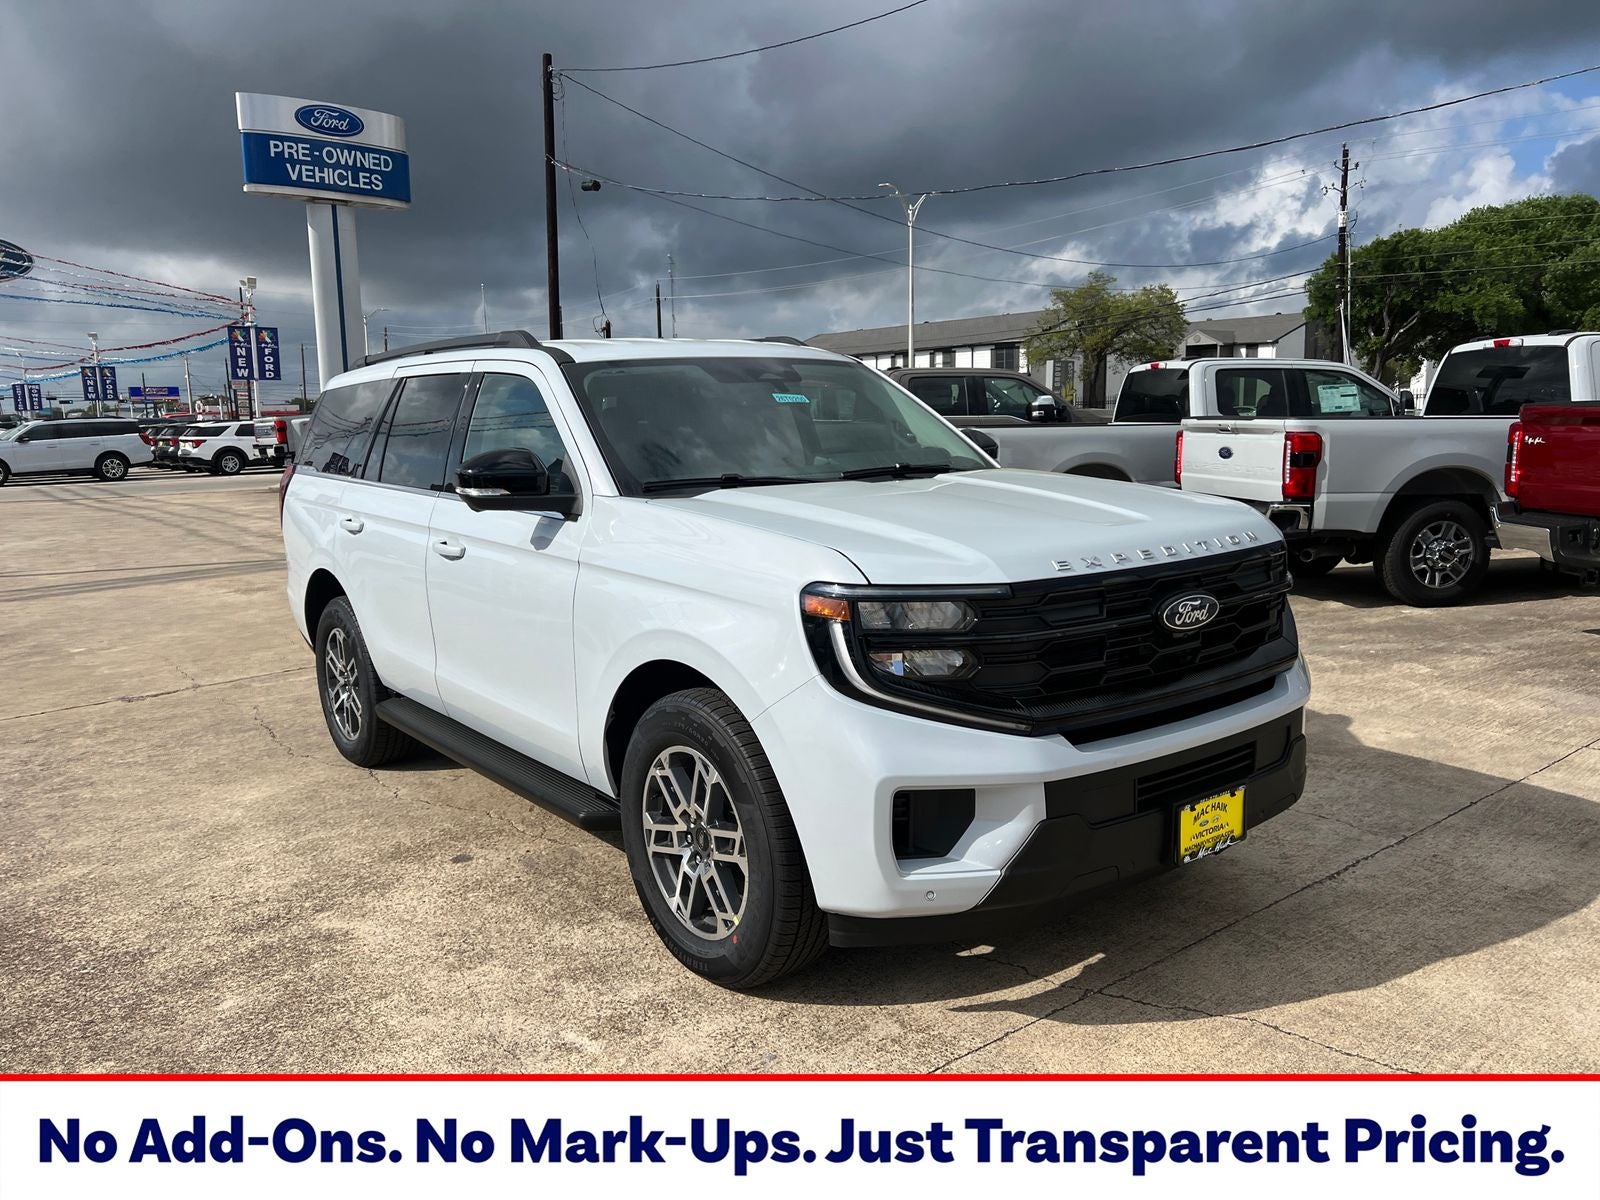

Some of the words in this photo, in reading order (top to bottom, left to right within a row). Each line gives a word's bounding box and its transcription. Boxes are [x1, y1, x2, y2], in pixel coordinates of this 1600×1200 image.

[310, 108, 349, 131] Ford
[286, 163, 383, 191] VEHICLES
[236, 347, 249, 377] NEW
[264, 348, 275, 378] FORD
[1051, 531, 1258, 571] EXPEDITION
[1175, 599, 1210, 625] Ford
[1193, 805, 1210, 826] MAC
[1211, 802, 1228, 813] HAIK
